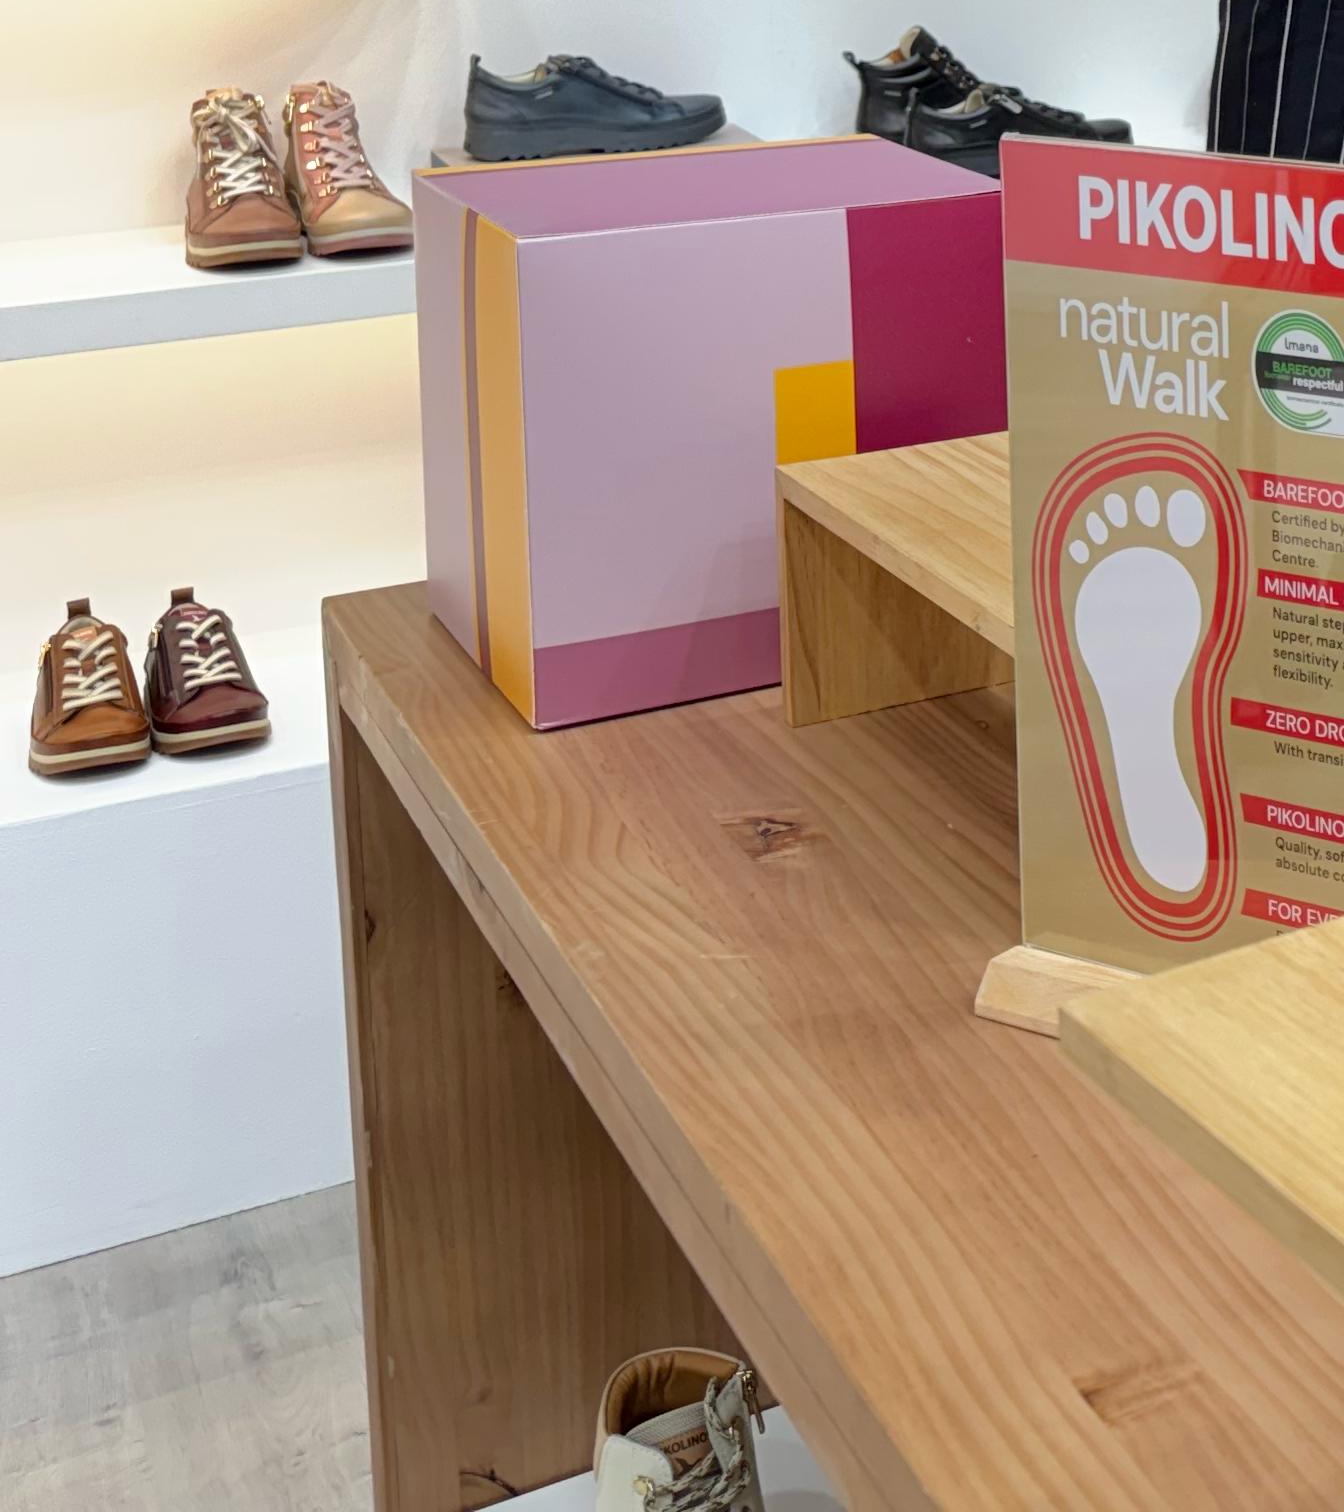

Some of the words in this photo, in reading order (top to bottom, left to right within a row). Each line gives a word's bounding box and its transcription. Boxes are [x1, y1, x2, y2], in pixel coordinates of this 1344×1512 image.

[1059, 297, 1230, 359] natural
[1272, 361, 1333, 379] BAREFOOT
[1098, 349, 1230, 422] Walk
[1292, 377, 1344, 393] respectful
[1271, 510, 1327, 531] Certified
[1272, 549, 1319, 569] Centre.
[1264, 575, 1339, 606] MINIMAL
[1272, 606, 1319, 627] Natural
[1273, 628, 1313, 646] upper,
[1273, 648, 1339, 672] sensitivity
[1273, 665, 1333, 690] flexibility.
[1265, 709, 1311, 735] ZERO
[1274, 740, 1304, 759] With
[1275, 836, 1322, 861] Quality,
[1275, 856, 1330, 879] absolute
[1268, 899, 1302, 924] FOR
